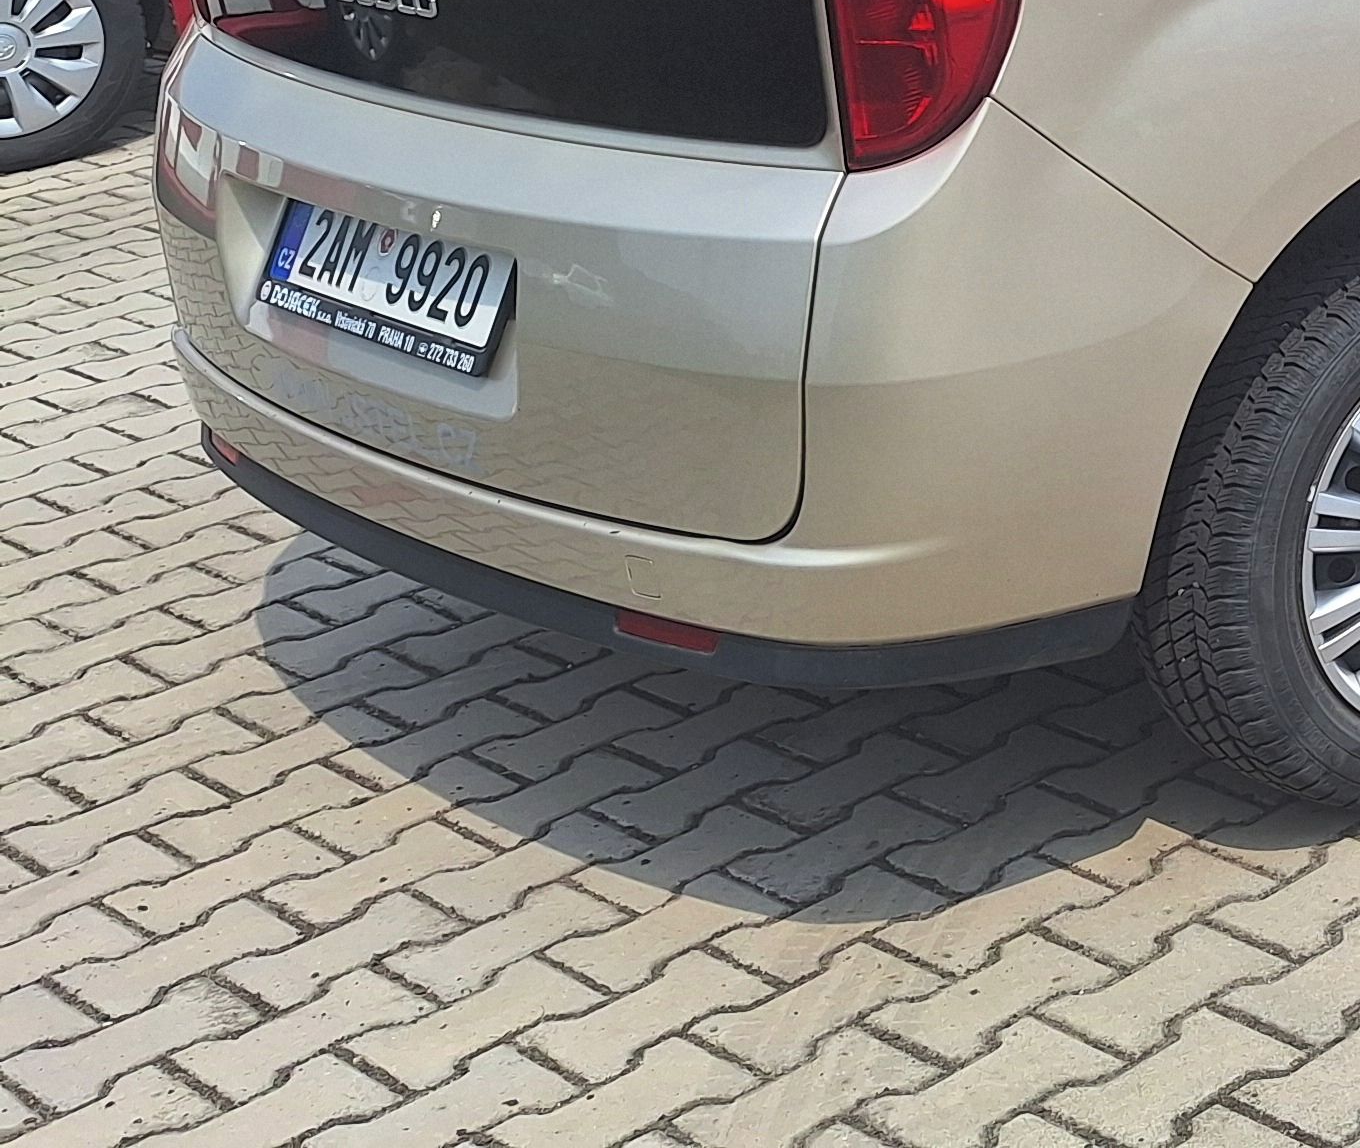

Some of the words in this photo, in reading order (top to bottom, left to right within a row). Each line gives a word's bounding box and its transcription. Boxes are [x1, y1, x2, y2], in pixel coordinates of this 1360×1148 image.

[277, 247, 297, 269] CZ
[298, 209, 377, 292] 2AM
[385, 233, 491, 328] 9920
[377, 325, 405, 349] PRAHA
[403, 334, 415, 353] 10
[426, 343, 444, 363] 272
[442, 348, 459, 368] 733
